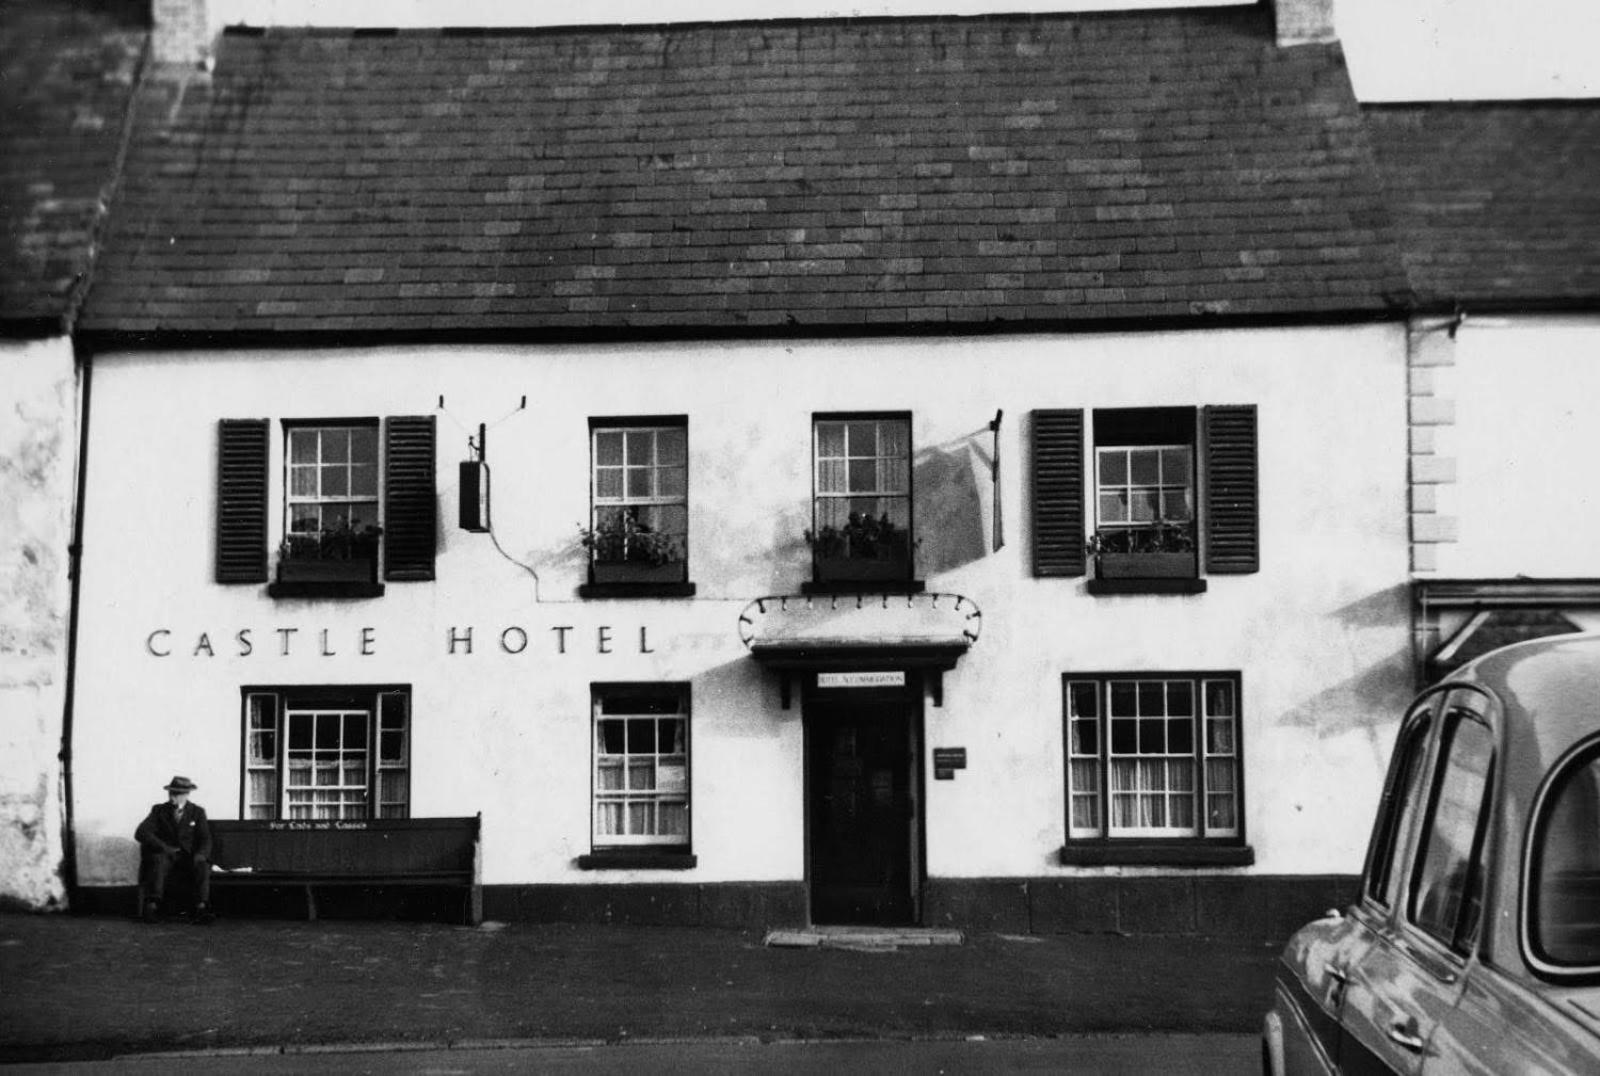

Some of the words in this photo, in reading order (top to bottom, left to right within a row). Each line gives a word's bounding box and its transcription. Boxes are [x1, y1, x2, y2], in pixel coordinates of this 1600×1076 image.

[146, 627, 376, 657] CASTLE
[449, 625, 656, 655] HOTEL
[269, 821, 285, 830] For
